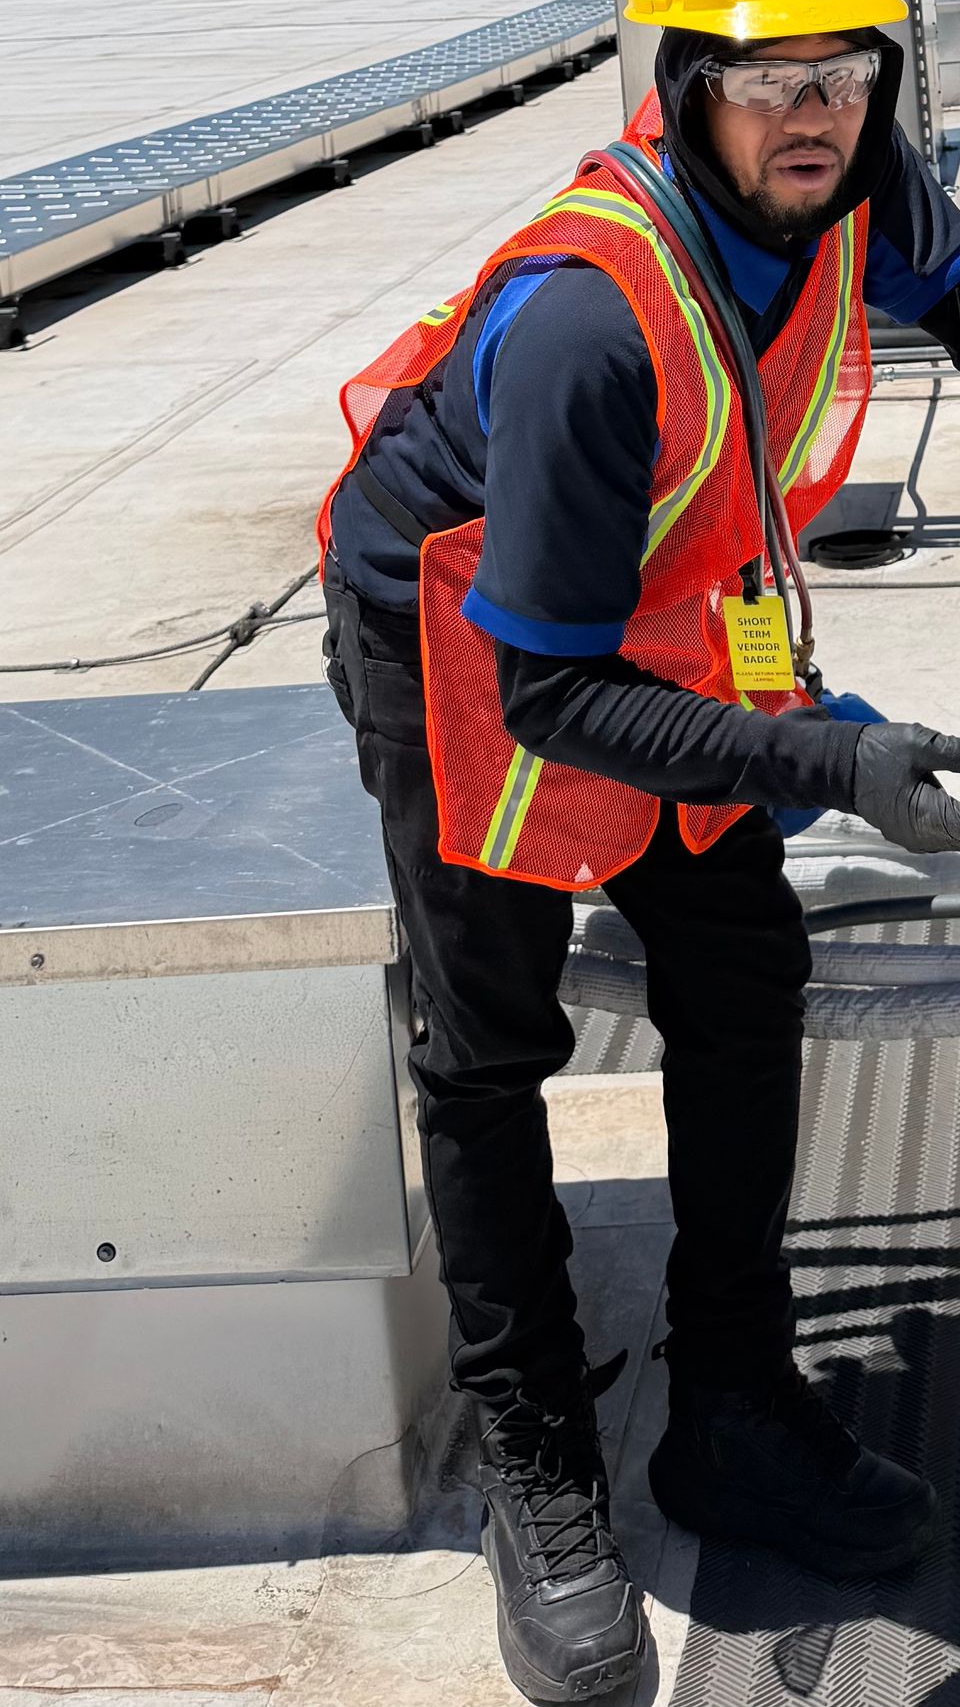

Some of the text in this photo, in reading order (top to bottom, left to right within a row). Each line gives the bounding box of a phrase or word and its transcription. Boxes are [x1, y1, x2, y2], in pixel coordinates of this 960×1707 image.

[737, 617, 772, 626] SHORT
[742, 630, 771, 639] TERM
[737, 643, 780, 651] VENDOR
[743, 655, 778, 664] BADGE
